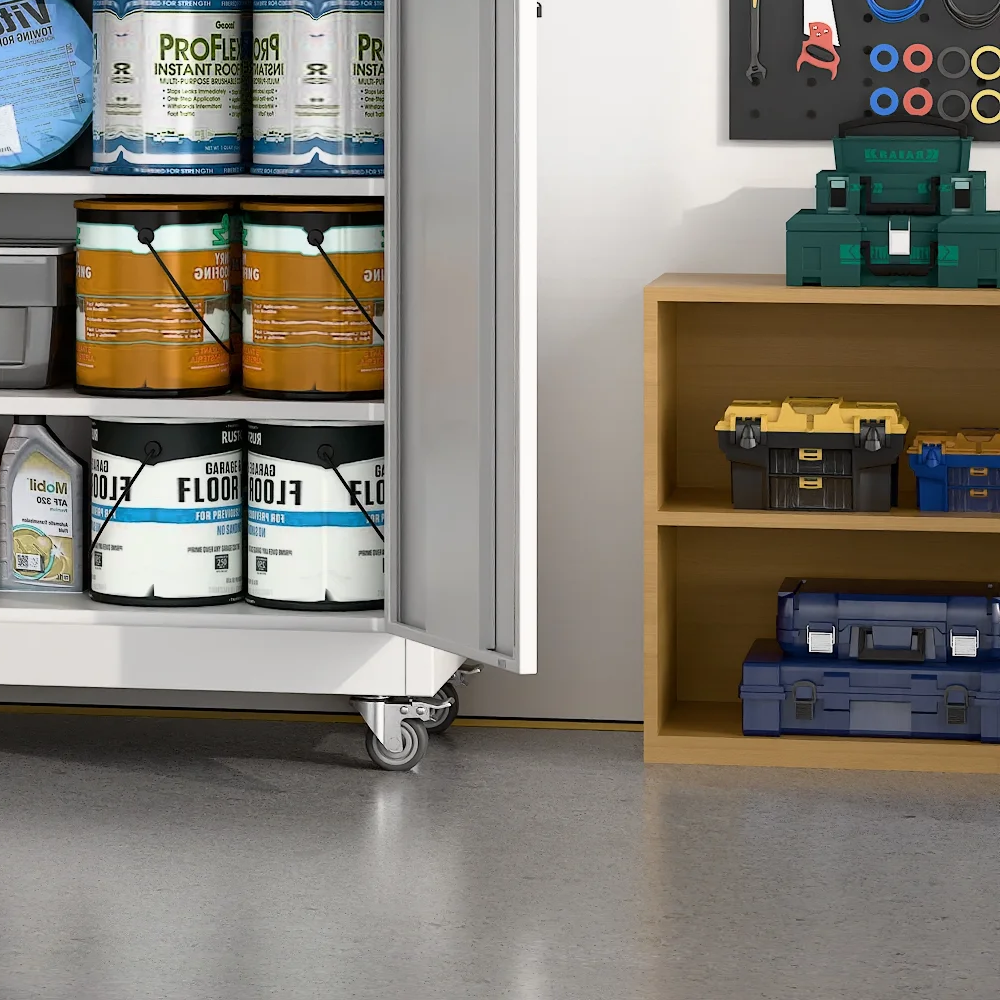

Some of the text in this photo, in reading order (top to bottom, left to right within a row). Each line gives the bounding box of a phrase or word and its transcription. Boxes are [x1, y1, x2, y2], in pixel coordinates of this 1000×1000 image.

[358, 33, 384, 61] PR
[155, 63, 213, 76] INSTANT
[178, 475, 238, 502] FLOOR
[195, 511, 212, 520] FOR
